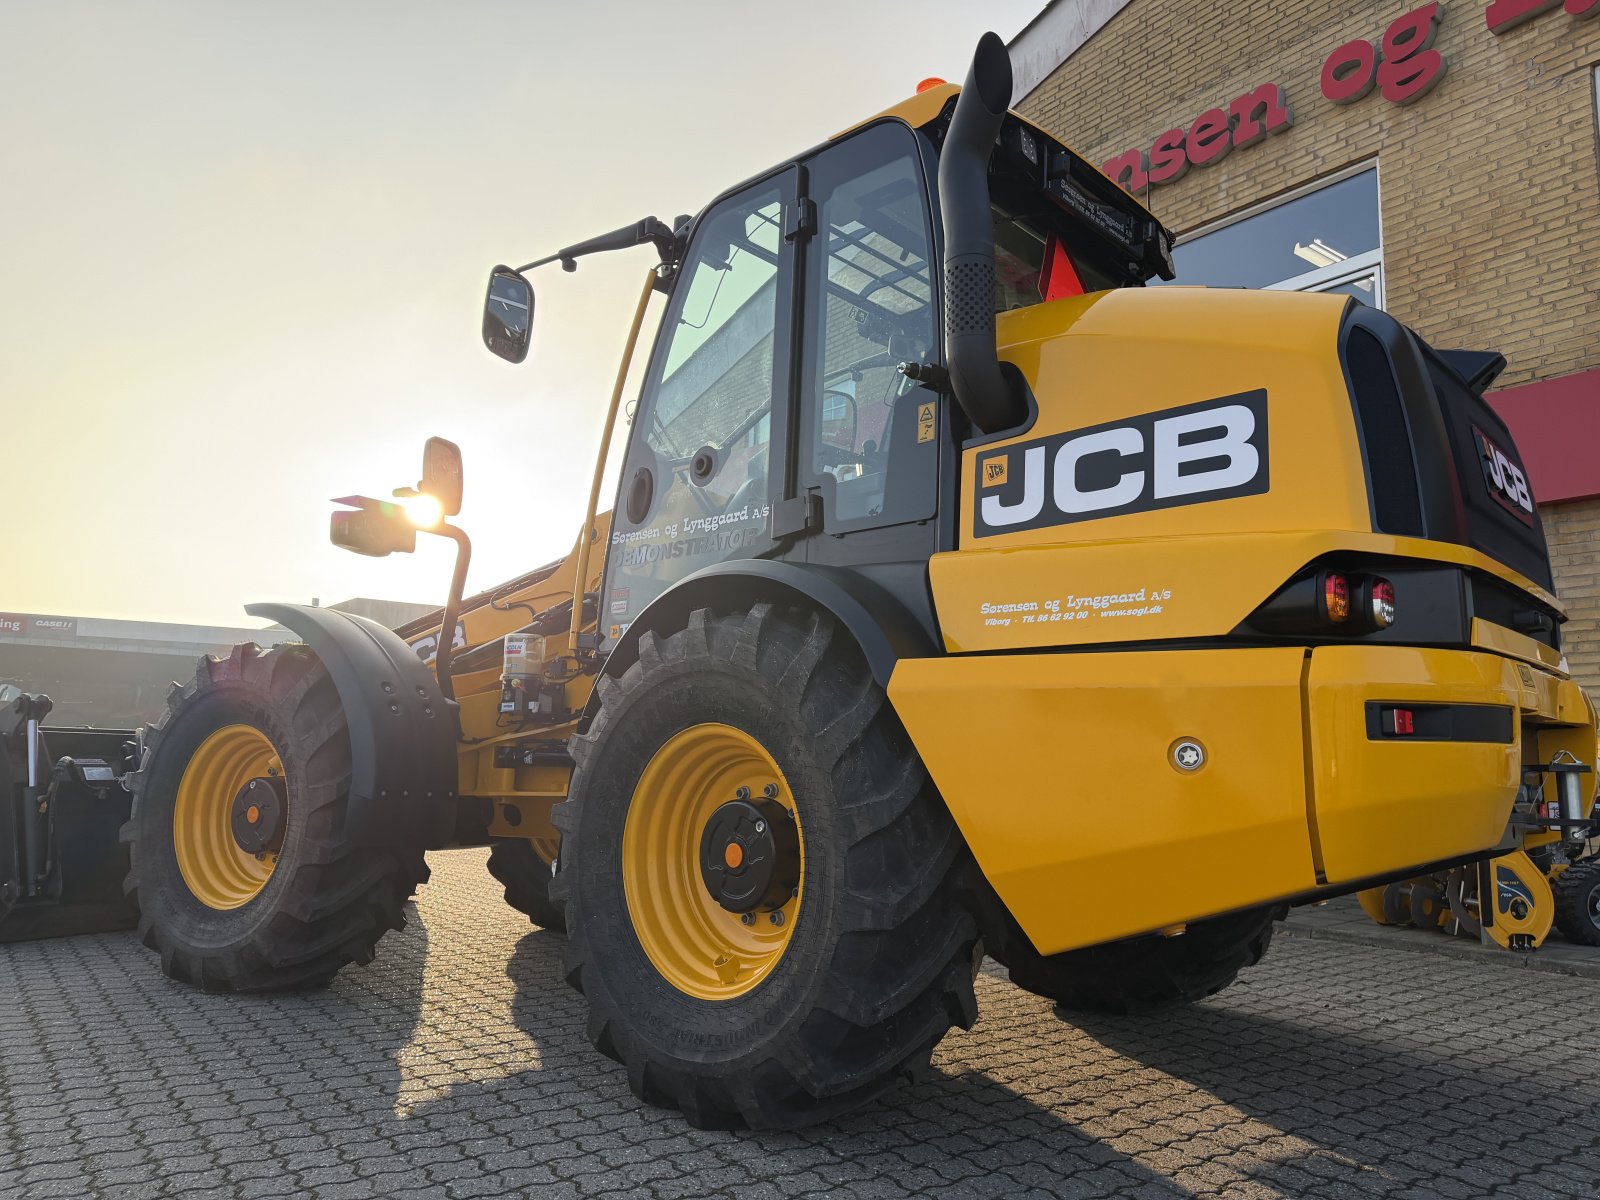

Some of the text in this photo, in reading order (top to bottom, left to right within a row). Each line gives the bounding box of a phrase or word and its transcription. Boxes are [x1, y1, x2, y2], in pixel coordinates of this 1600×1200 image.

[1319, 1, 1444, 104] og
[981, 404, 1260, 527] JCB
[986, 464, 1005, 481] JCB
[1488, 442, 1533, 513] JCB
[664, 523, 678, 539] og
[683, 505, 749, 534] Lynggaard
[752, 504, 770, 520] A/S
[611, 527, 760, 569] DEMONSTRATOR
[980, 588, 1171, 615] Sørensen og Lynggaard A/S
[985, 617, 1011, 627] Viborg
[1037, 614, 1048, 622] 86
[1050, 613, 1062, 621] 62
[1063, 612, 1075, 620] 92
[1076, 611, 1088, 619] 00
[1100, 605, 1163, 618] www.sogl.dk
